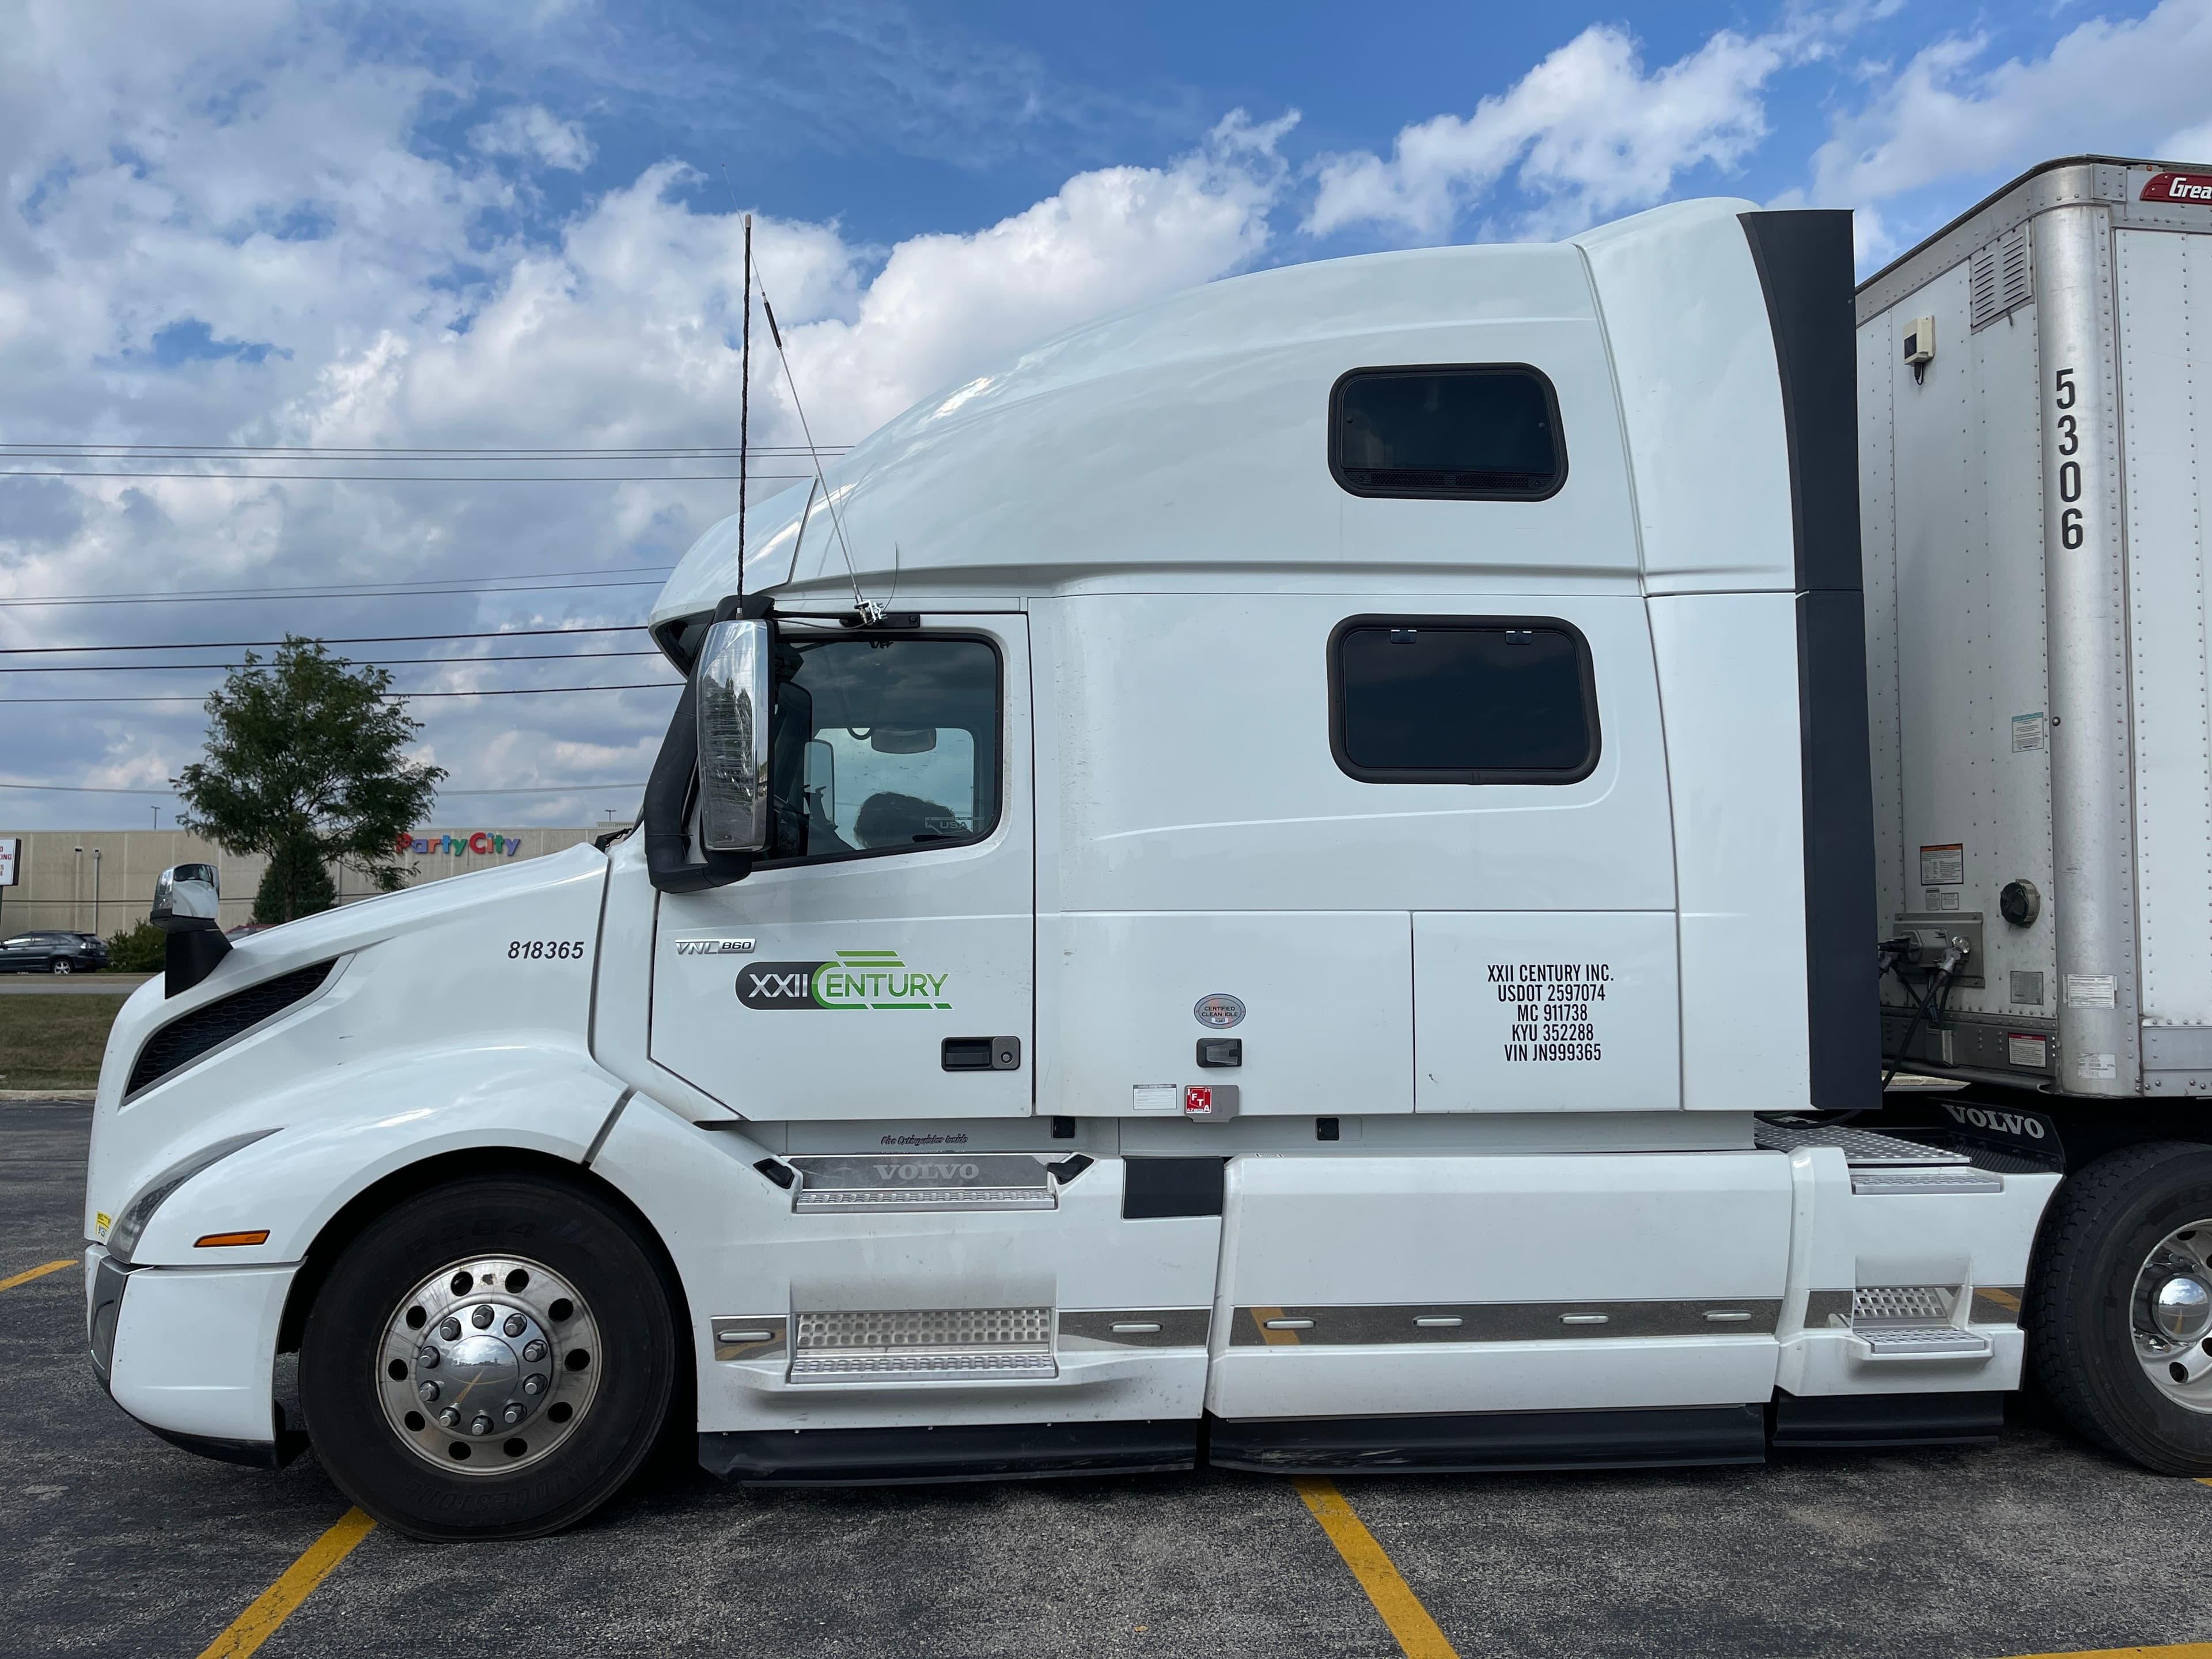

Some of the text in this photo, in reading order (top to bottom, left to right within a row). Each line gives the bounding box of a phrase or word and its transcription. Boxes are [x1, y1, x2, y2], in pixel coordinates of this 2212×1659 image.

[2056, 368, 2084, 550] 5306
[940, 821, 968, 829] USA
[507, 941, 585, 959] 818365
[675, 941, 719, 955] VNL
[1487, 964, 1614, 982] XXII CENTURY INC.
[748, 960, 950, 1010] XXII CENTURY
[1498, 984, 1605, 1002] USDOT 2597074
[1517, 1004, 1588, 1021] MC 911738
[1512, 1024, 1594, 1041] KYU 352288
[1504, 1043, 1601, 1061] VIN JN999365
[1941, 1104, 2045, 1139] VOLVO
[873, 1164, 979, 1180] VOLVO
